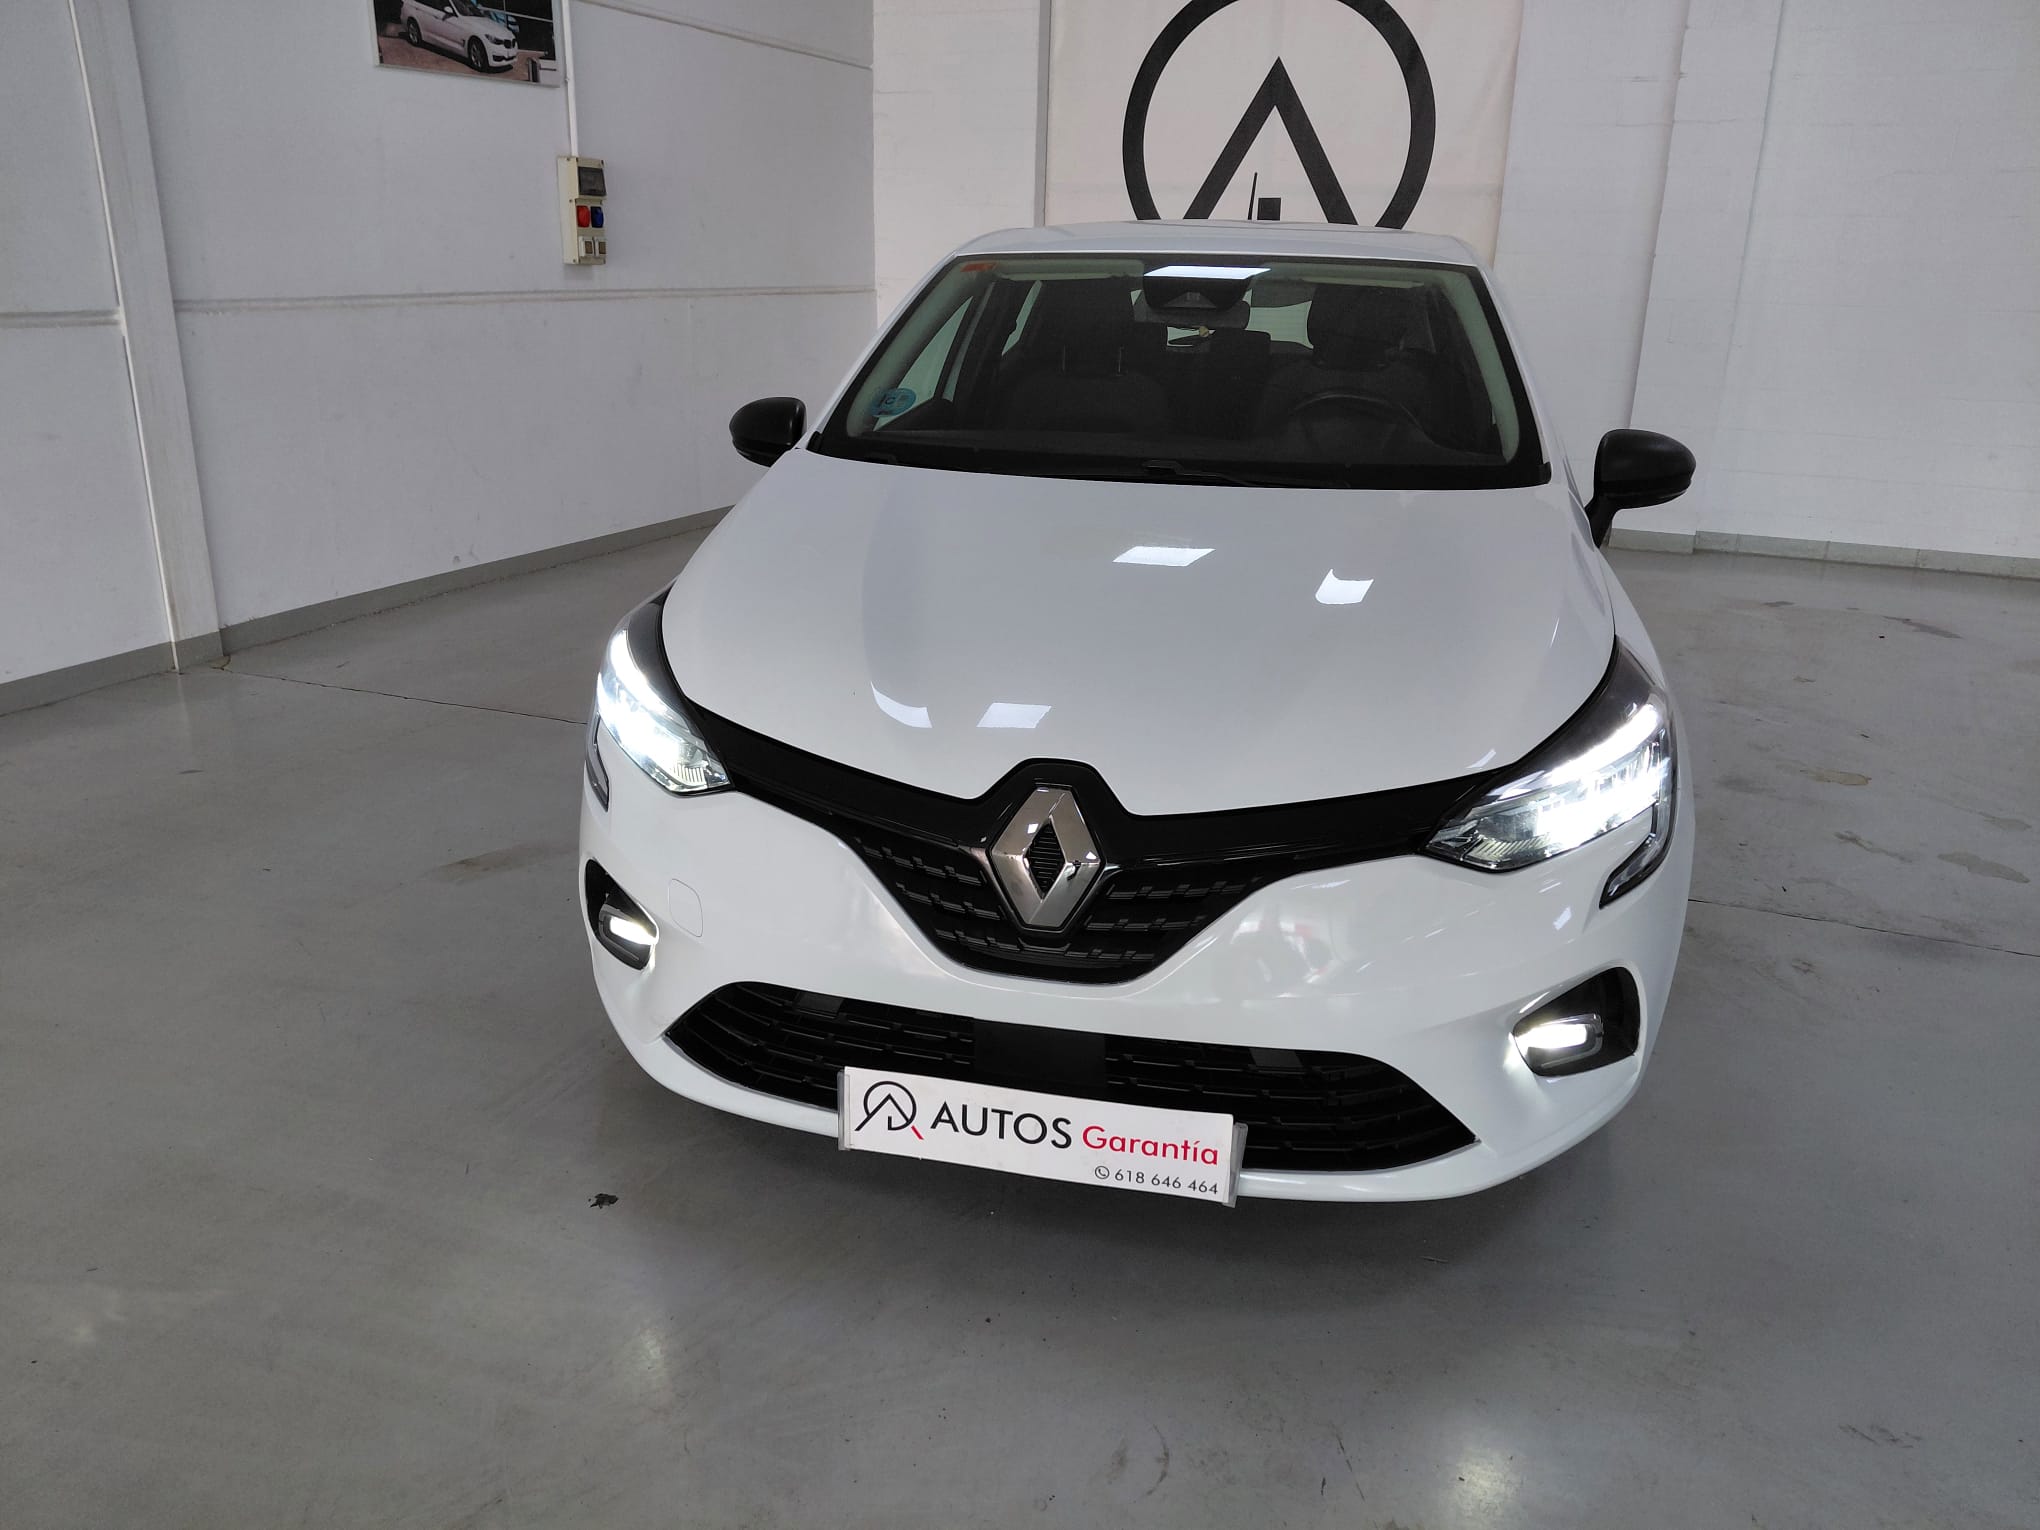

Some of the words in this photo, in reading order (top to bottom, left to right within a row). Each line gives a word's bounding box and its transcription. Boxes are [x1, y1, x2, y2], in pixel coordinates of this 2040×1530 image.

[930, 1101, 1072, 1149] AUTOS
[1082, 1125, 1218, 1165] Garantía
[1114, 1168, 1145, 1184] 618
[1150, 1173, 1182, 1189] 646
[1187, 1179, 1218, 1195] 464
